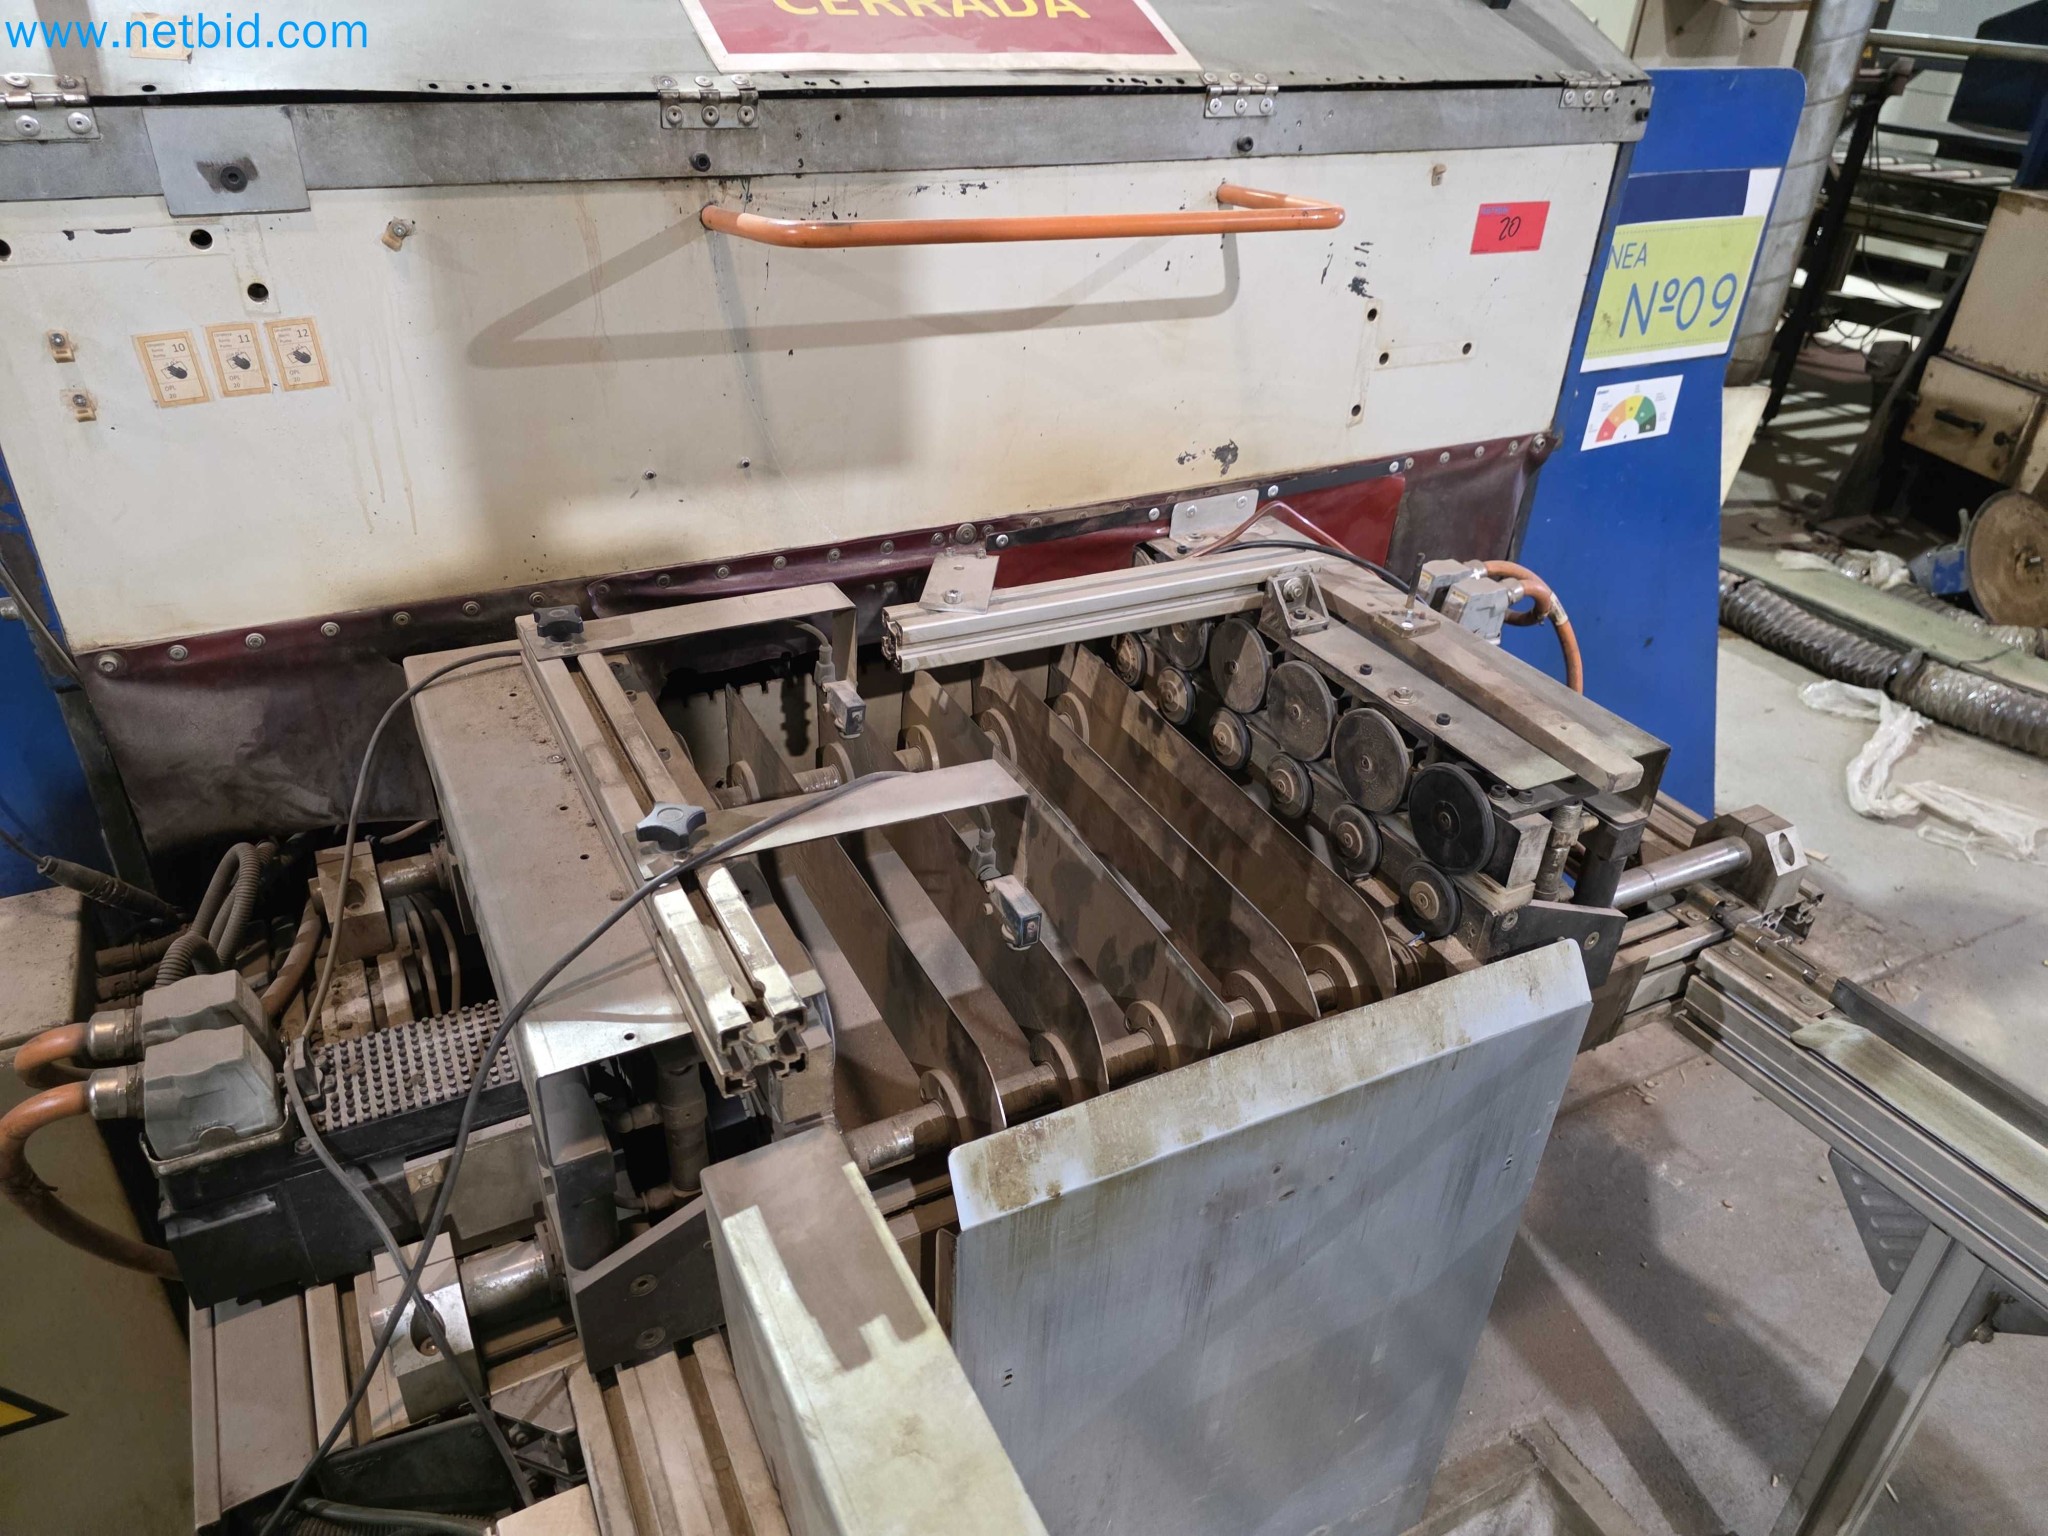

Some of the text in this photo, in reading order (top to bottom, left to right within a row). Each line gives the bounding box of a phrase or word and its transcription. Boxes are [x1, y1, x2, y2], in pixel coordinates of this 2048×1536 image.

[773, 0, 1091, 18] CERRADA
[1499, 216, 1521, 241] 20
[296, 328, 310, 338] 12
[238, 334, 250, 344] 11
[171, 342, 186, 353] 10
